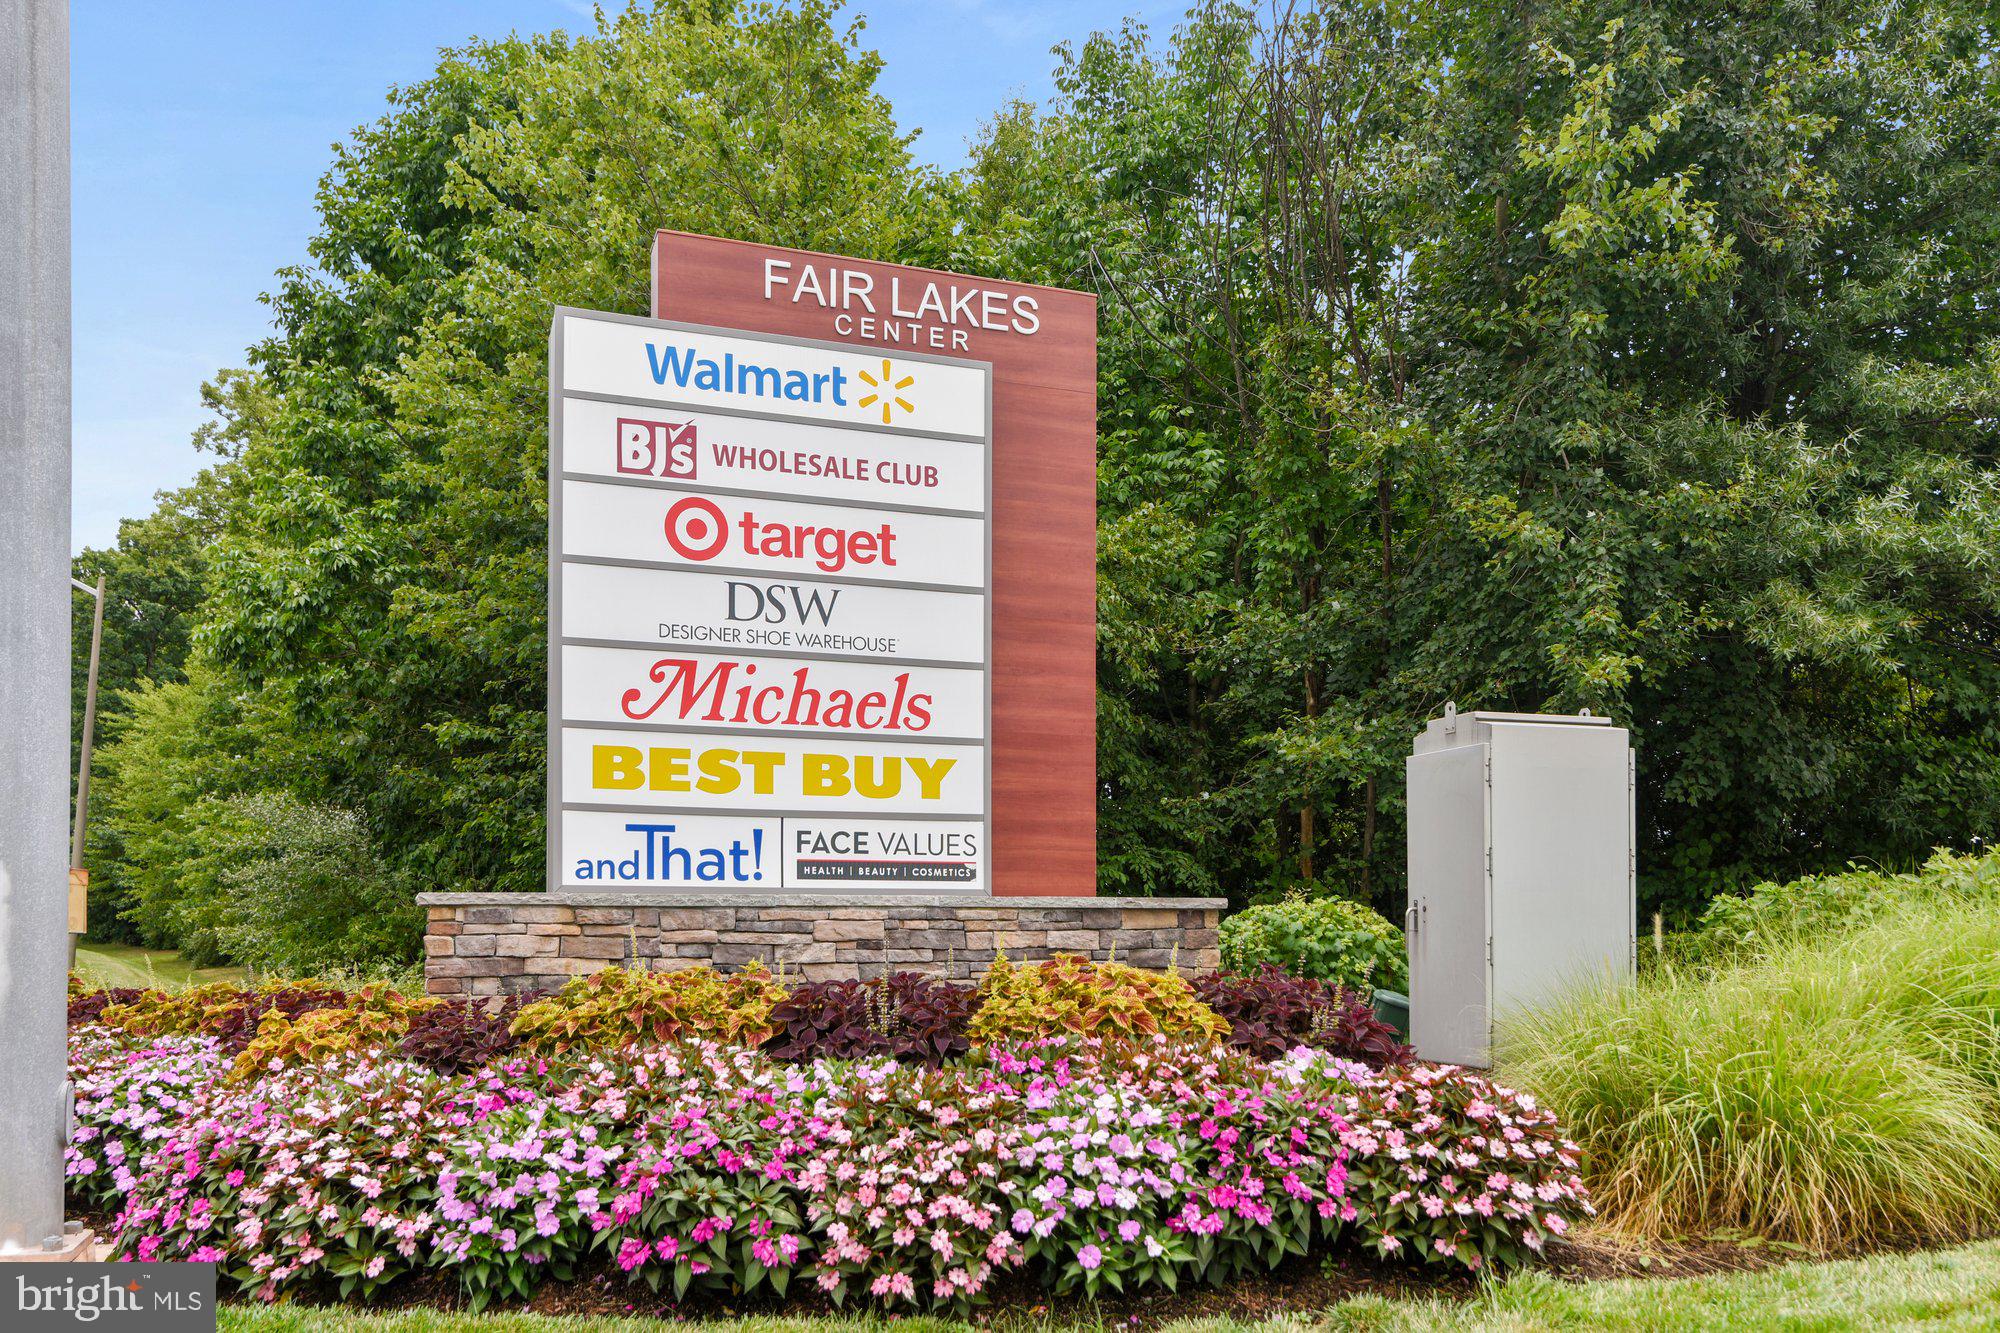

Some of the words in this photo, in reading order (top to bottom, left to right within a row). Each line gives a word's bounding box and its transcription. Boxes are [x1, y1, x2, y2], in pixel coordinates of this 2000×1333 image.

[763, 258, 875, 313] FAIR
[890, 277, 1041, 335] LAKES
[834, 314, 969, 352] CENTER
[645, 343, 847, 407] Walmart
[712, 443, 870, 482] WHOLESALE
[876, 461, 939, 487] CLUB
[738, 512, 898, 574] target
[724, 581, 842, 628] DSW
[658, 623, 742, 644] DESIGNER
[746, 631, 791, 647] SHOE
[621, 659, 933, 732] Michaels
[592, 744, 786, 795] BEST
[802, 753, 958, 800] BUY
[796, 830, 869, 855] FACE
[877, 833, 978, 857] VALUES
[803, 865, 845, 876] HEALTH
[857, 867, 899, 877] BEAUTY
[911, 867, 972, 878] COSMETICS
